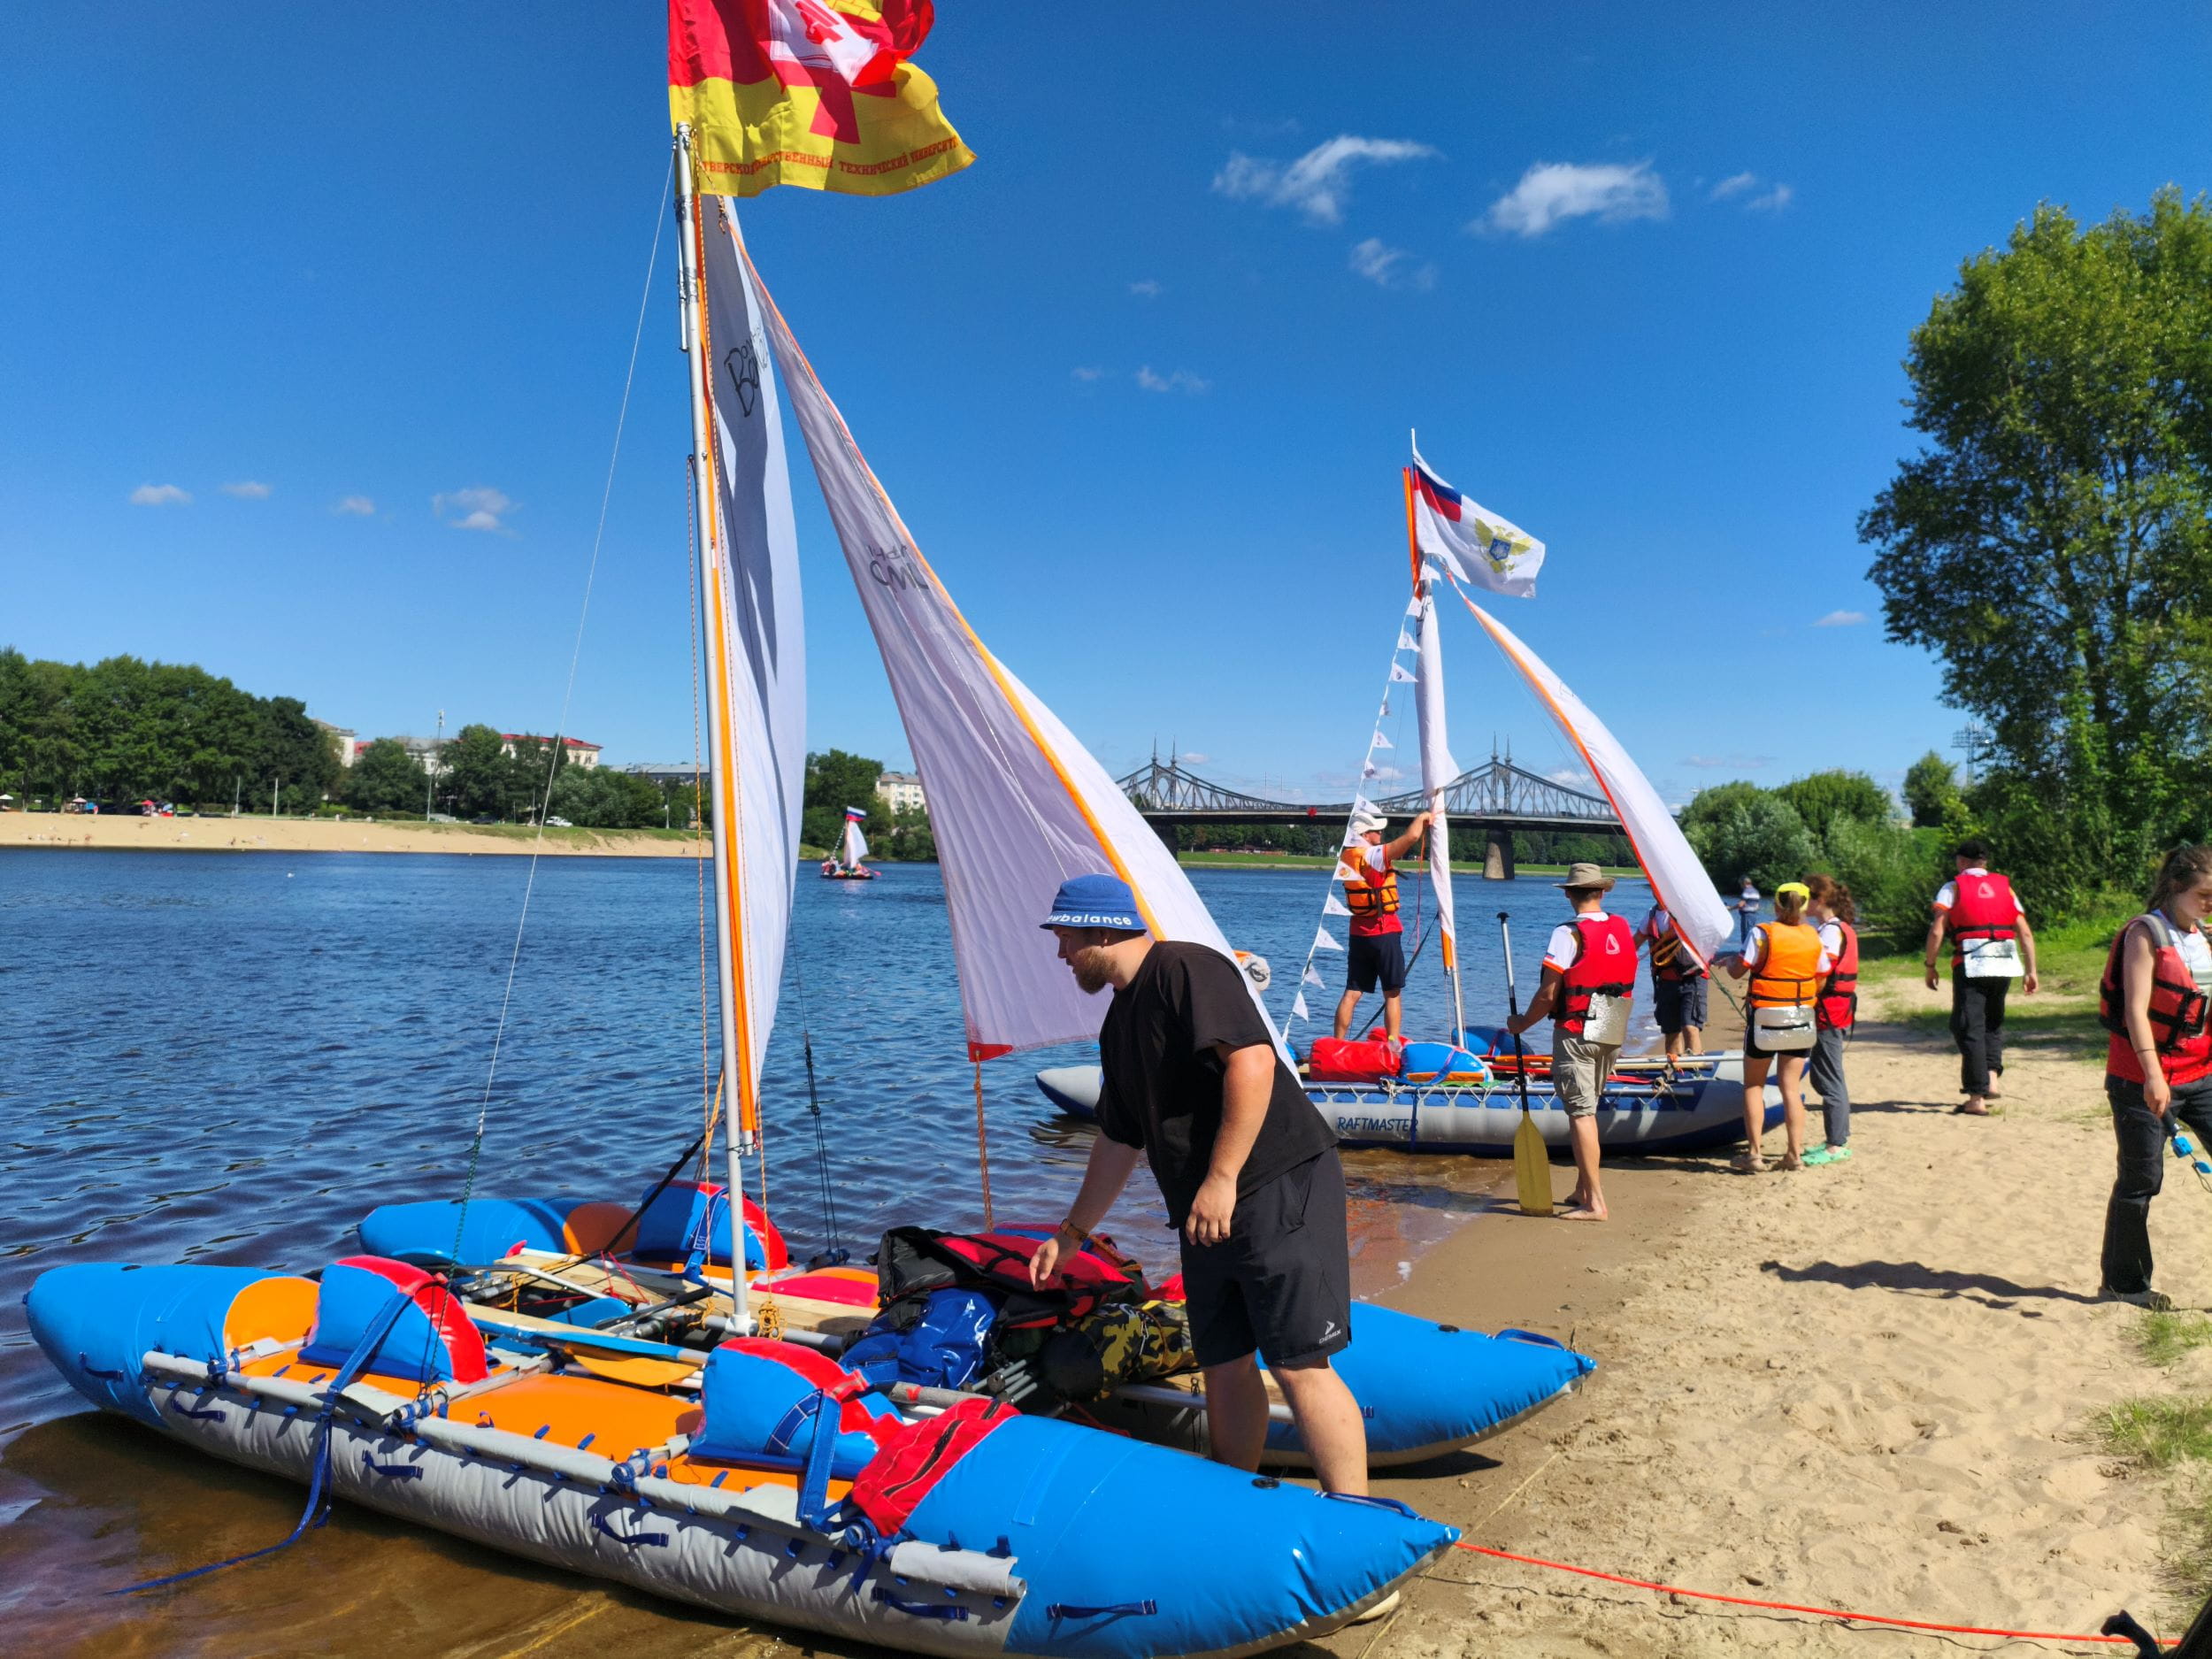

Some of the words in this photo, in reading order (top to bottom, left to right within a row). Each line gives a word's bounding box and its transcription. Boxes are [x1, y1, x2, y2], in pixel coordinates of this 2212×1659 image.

[839, 152, 909, 175] ТЕХНИЧЕСКИЙ
[1337, 1117, 1419, 1132] RAFTMASTER
[1318, 1329, 1341, 1344] DEMIX
